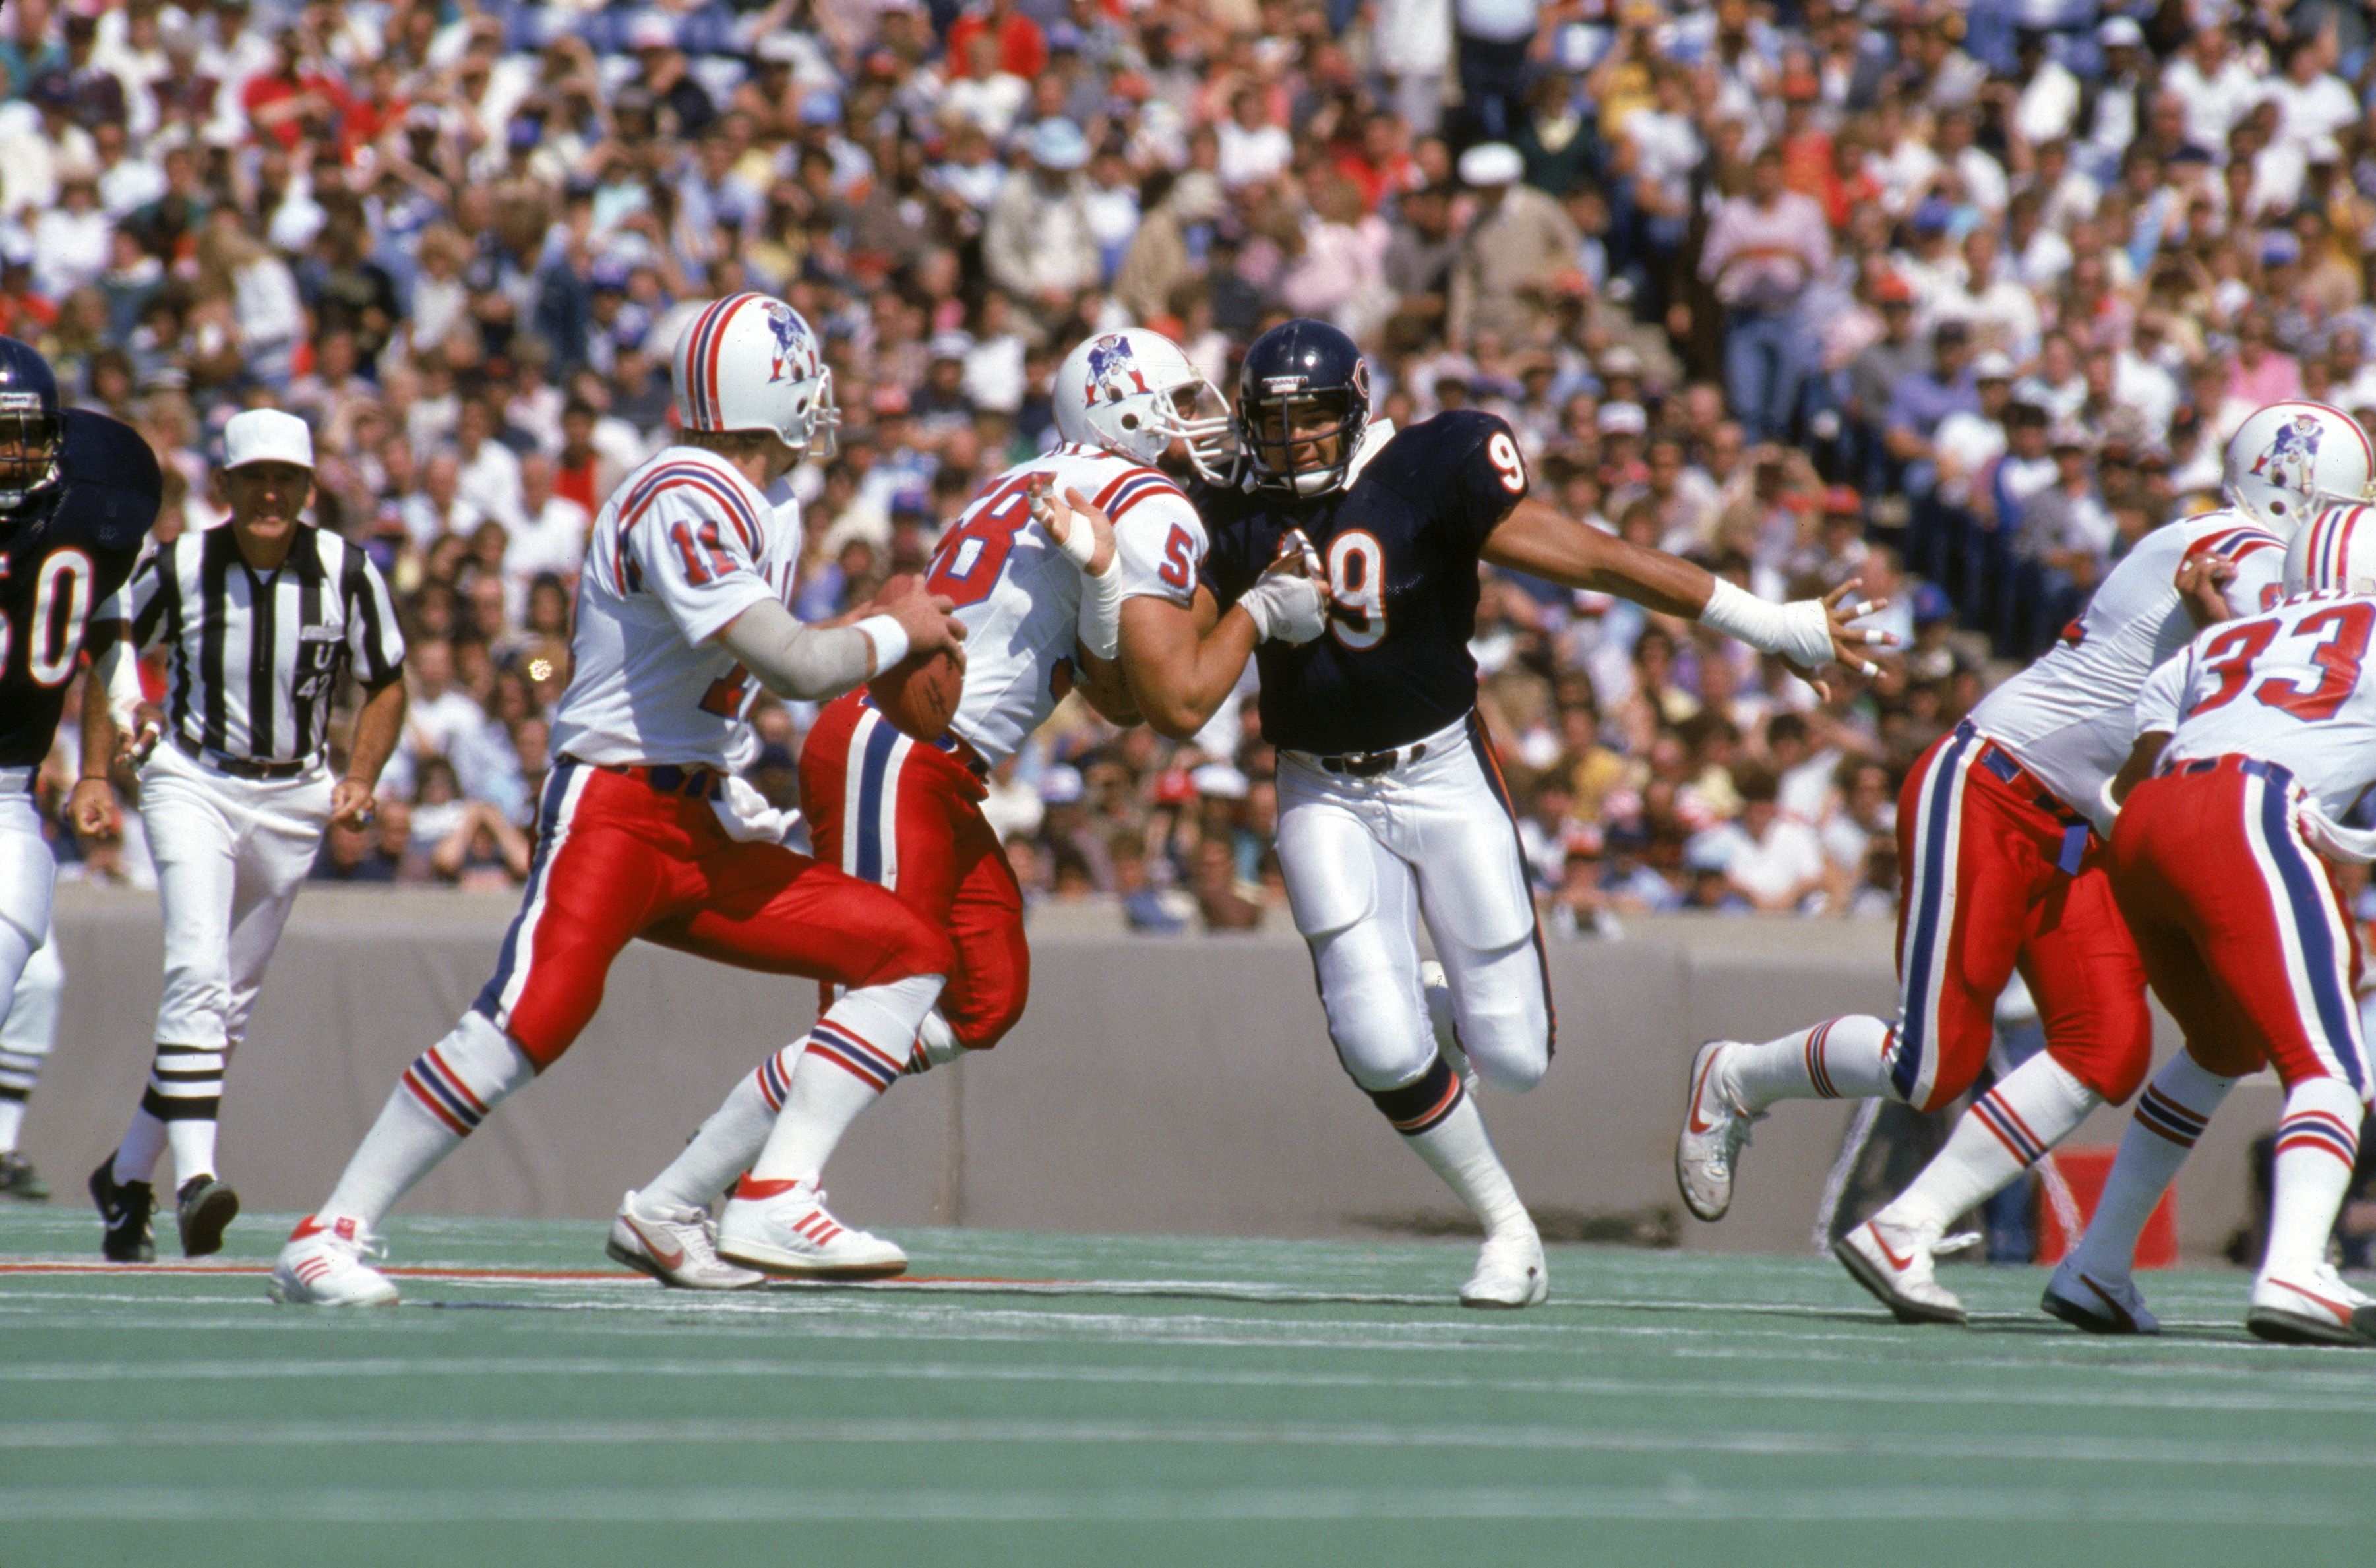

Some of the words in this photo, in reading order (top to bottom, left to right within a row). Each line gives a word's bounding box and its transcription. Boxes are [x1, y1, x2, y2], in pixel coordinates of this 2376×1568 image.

[1488, 431, 1525, 494] 9
[670, 520, 740, 588] 11
[314, 643, 334, 669] U
[2187, 601, 2376, 723] 33
